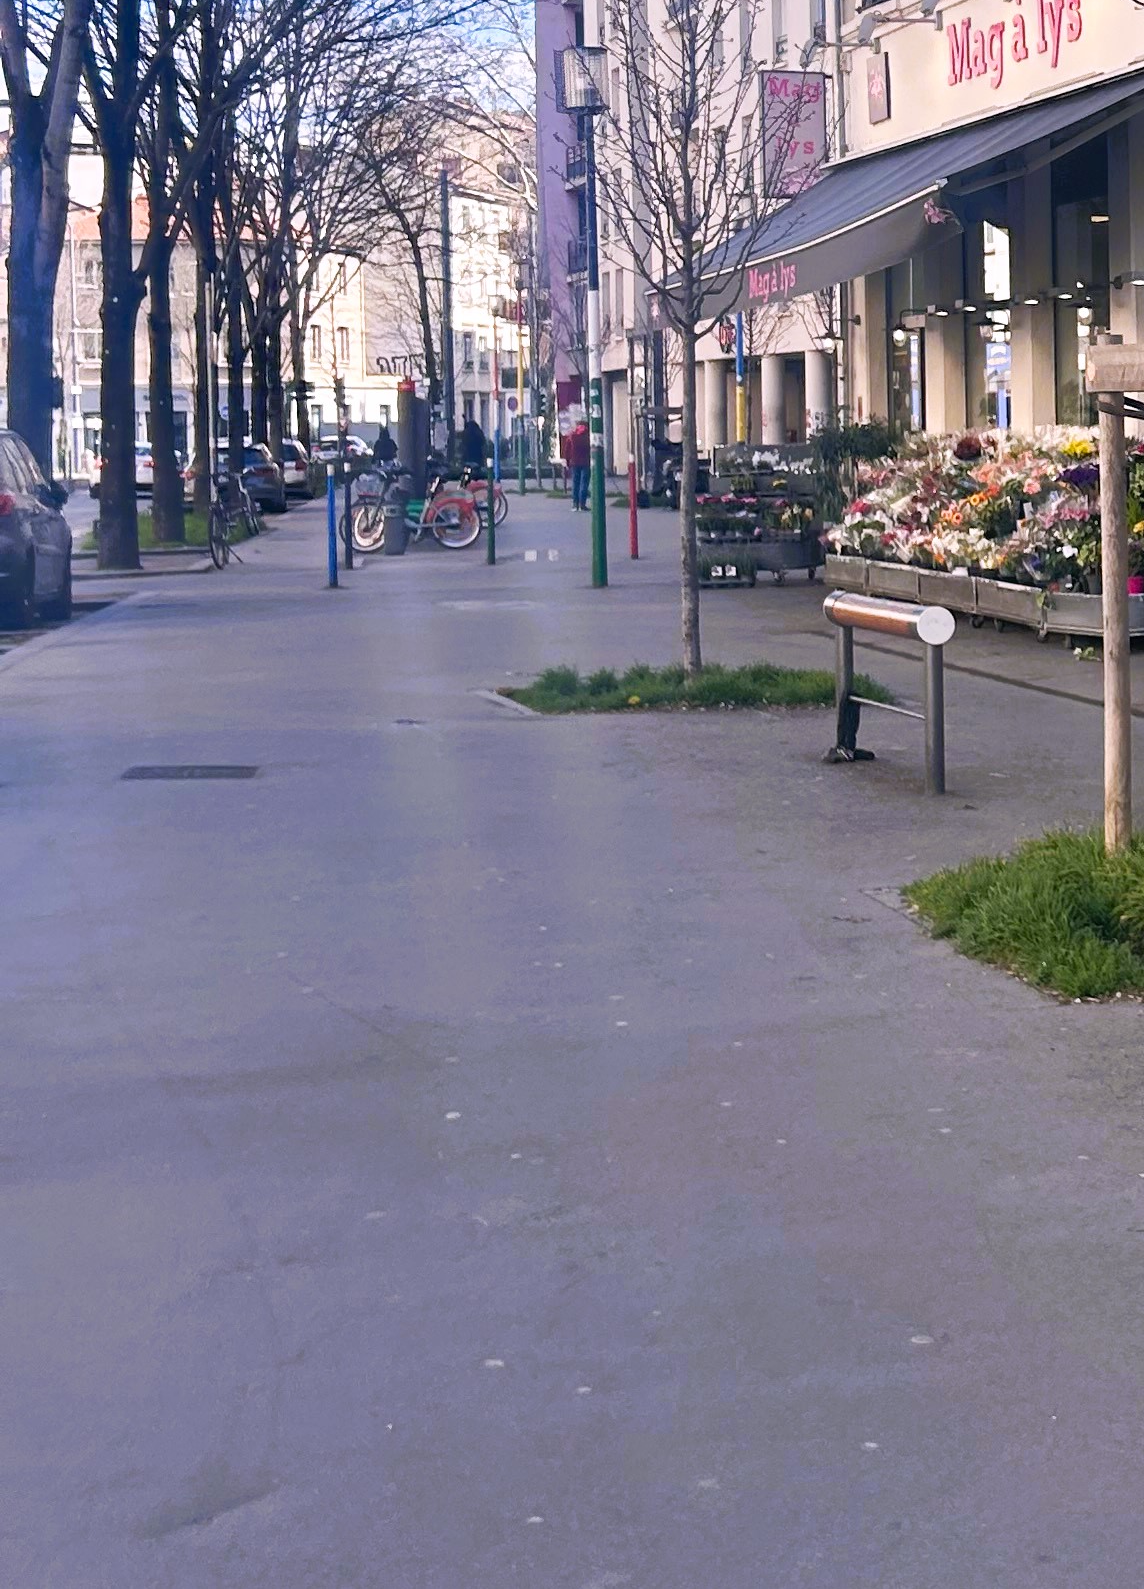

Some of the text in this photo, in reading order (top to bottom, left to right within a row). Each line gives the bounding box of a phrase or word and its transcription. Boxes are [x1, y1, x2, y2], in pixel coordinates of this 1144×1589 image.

[946, 16, 1005, 90] Mag
[767, 76, 822, 104] Mag
[748, 267, 771, 304] Mag
